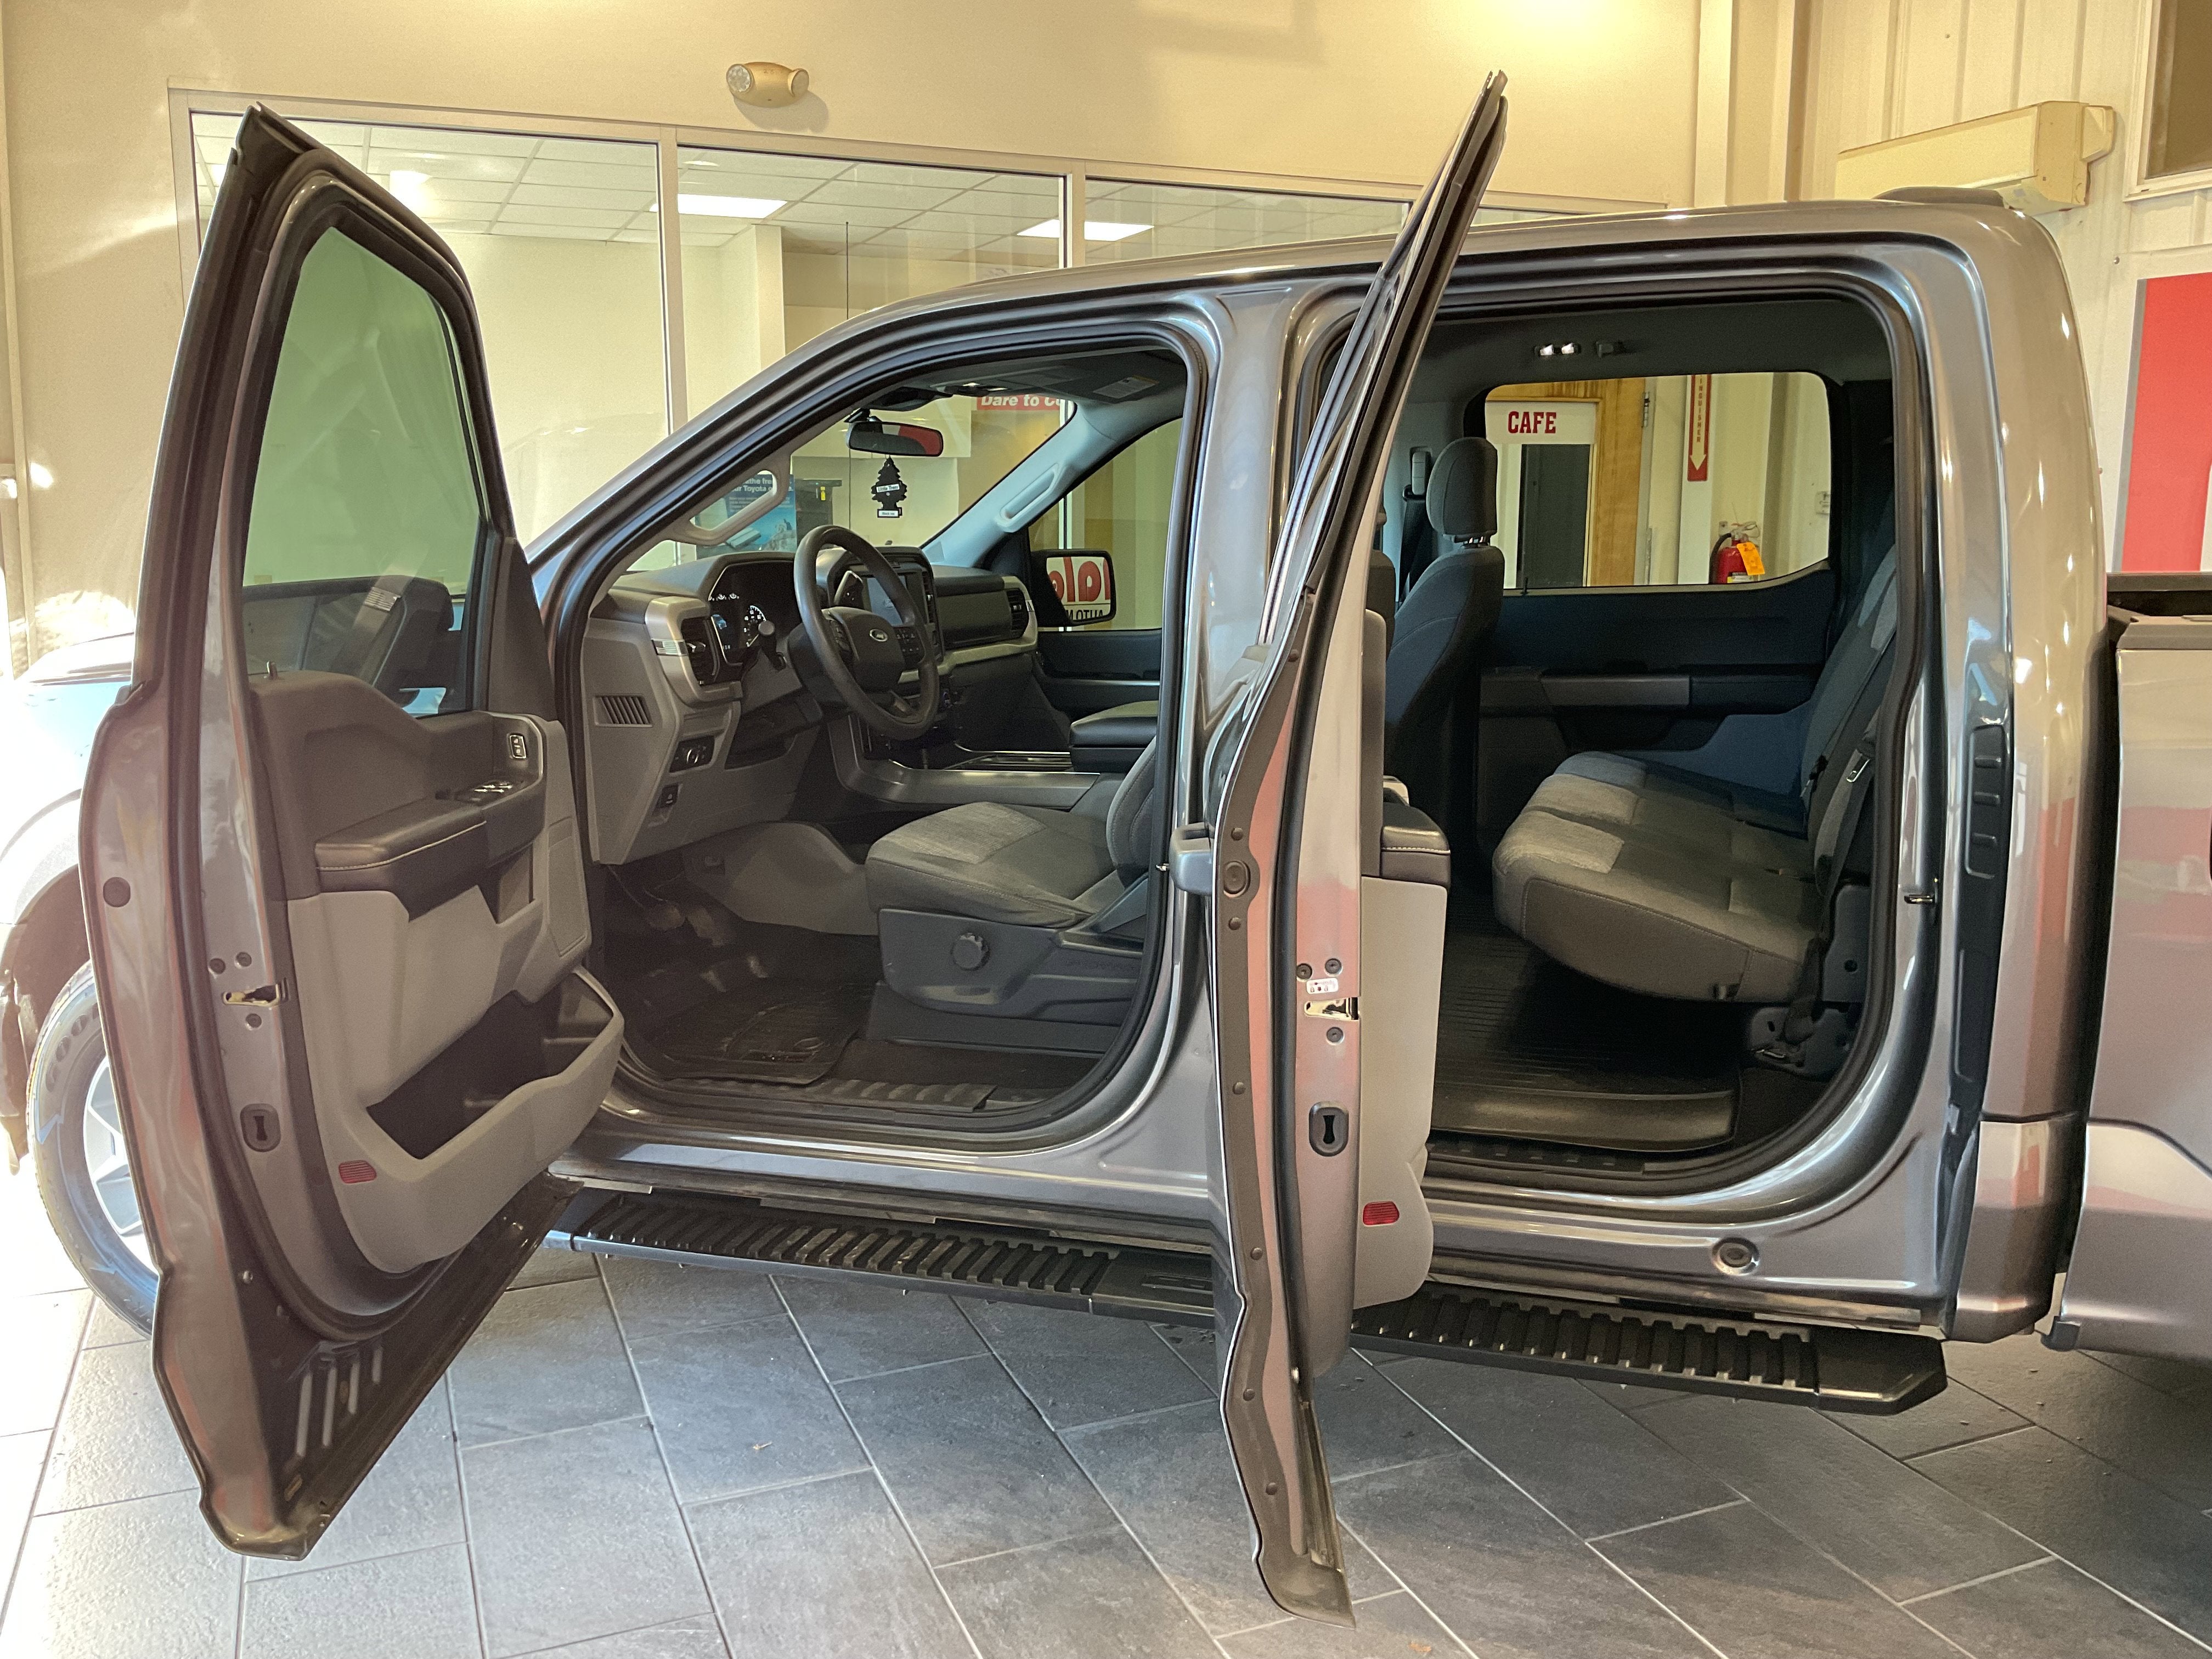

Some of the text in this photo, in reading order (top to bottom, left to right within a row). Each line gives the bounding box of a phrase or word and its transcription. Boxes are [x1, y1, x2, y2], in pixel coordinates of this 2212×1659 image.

[981, 396, 1018, 407] Dare
[1023, 394, 1040, 407] to
[1508, 410, 1557, 434] CAFE
